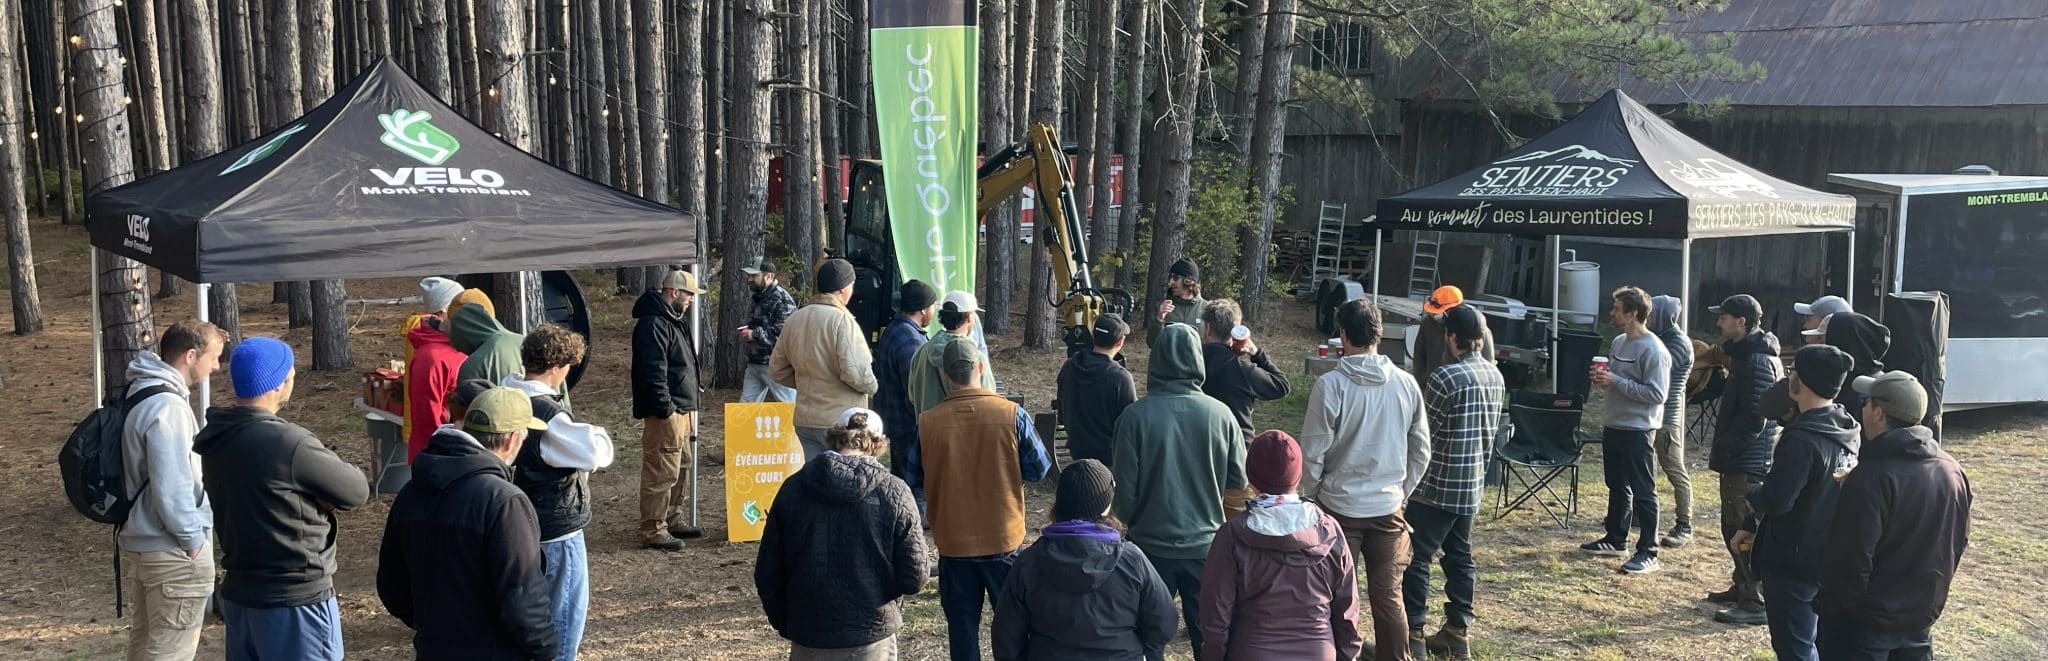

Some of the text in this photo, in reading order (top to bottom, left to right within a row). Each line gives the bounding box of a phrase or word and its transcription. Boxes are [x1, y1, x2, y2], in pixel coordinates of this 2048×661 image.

[369, 167, 505, 187] VELO
[1473, 165, 1628, 188] SENTIERS
[360, 185, 532, 196] Mont-Tremblant
[1458, 187, 1488, 196] DES
[1400, 200, 1653, 228] Au sommet des Laurentides !
[1695, 204, 1741, 229] SENTIERS
[1745, 202, 1765, 227] DES
[735, 452, 788, 466] ÉVÉNEMENT
[755, 472, 783, 483] COURS
